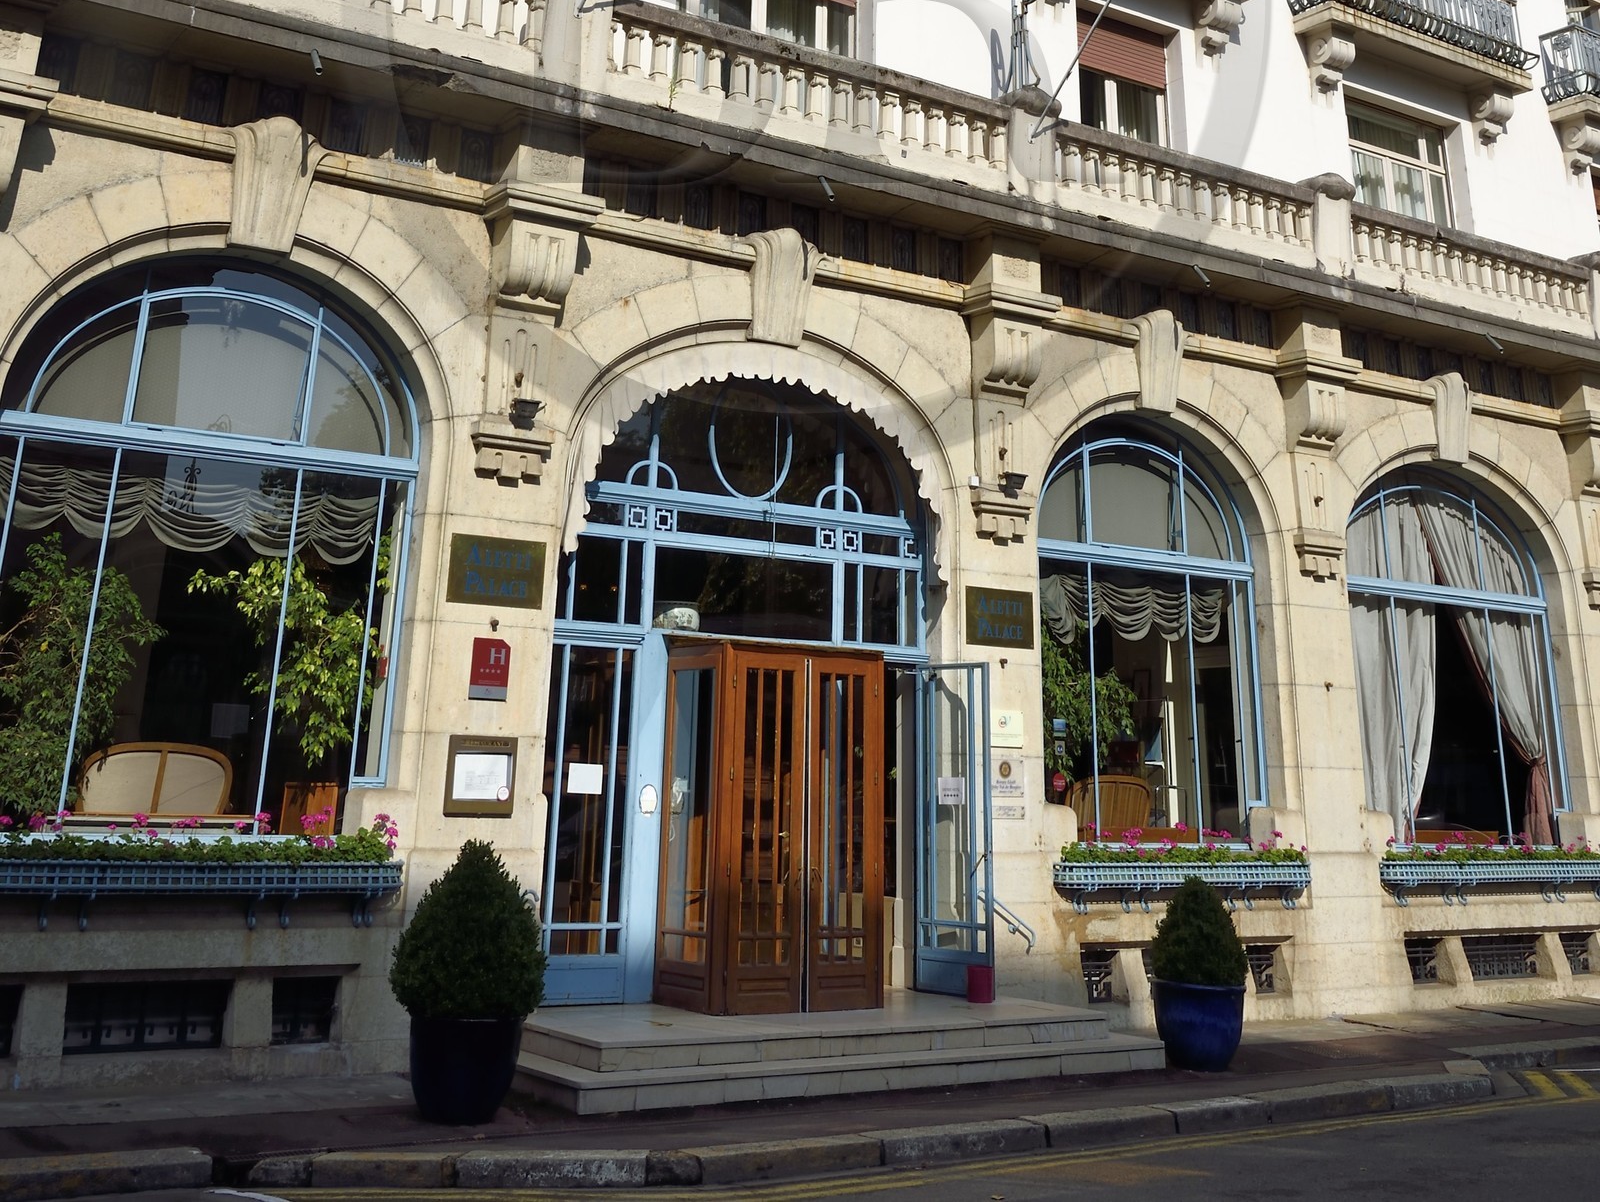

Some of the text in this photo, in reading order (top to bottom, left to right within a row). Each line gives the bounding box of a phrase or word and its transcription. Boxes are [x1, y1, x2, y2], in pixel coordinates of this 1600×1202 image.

[465, 542, 532, 571] ALETTI
[464, 570, 528, 598] PALACE
[977, 595, 1023, 616] ALETTI
[977, 617, 1023, 639] PALACE
[489, 647, 506, 665] H
